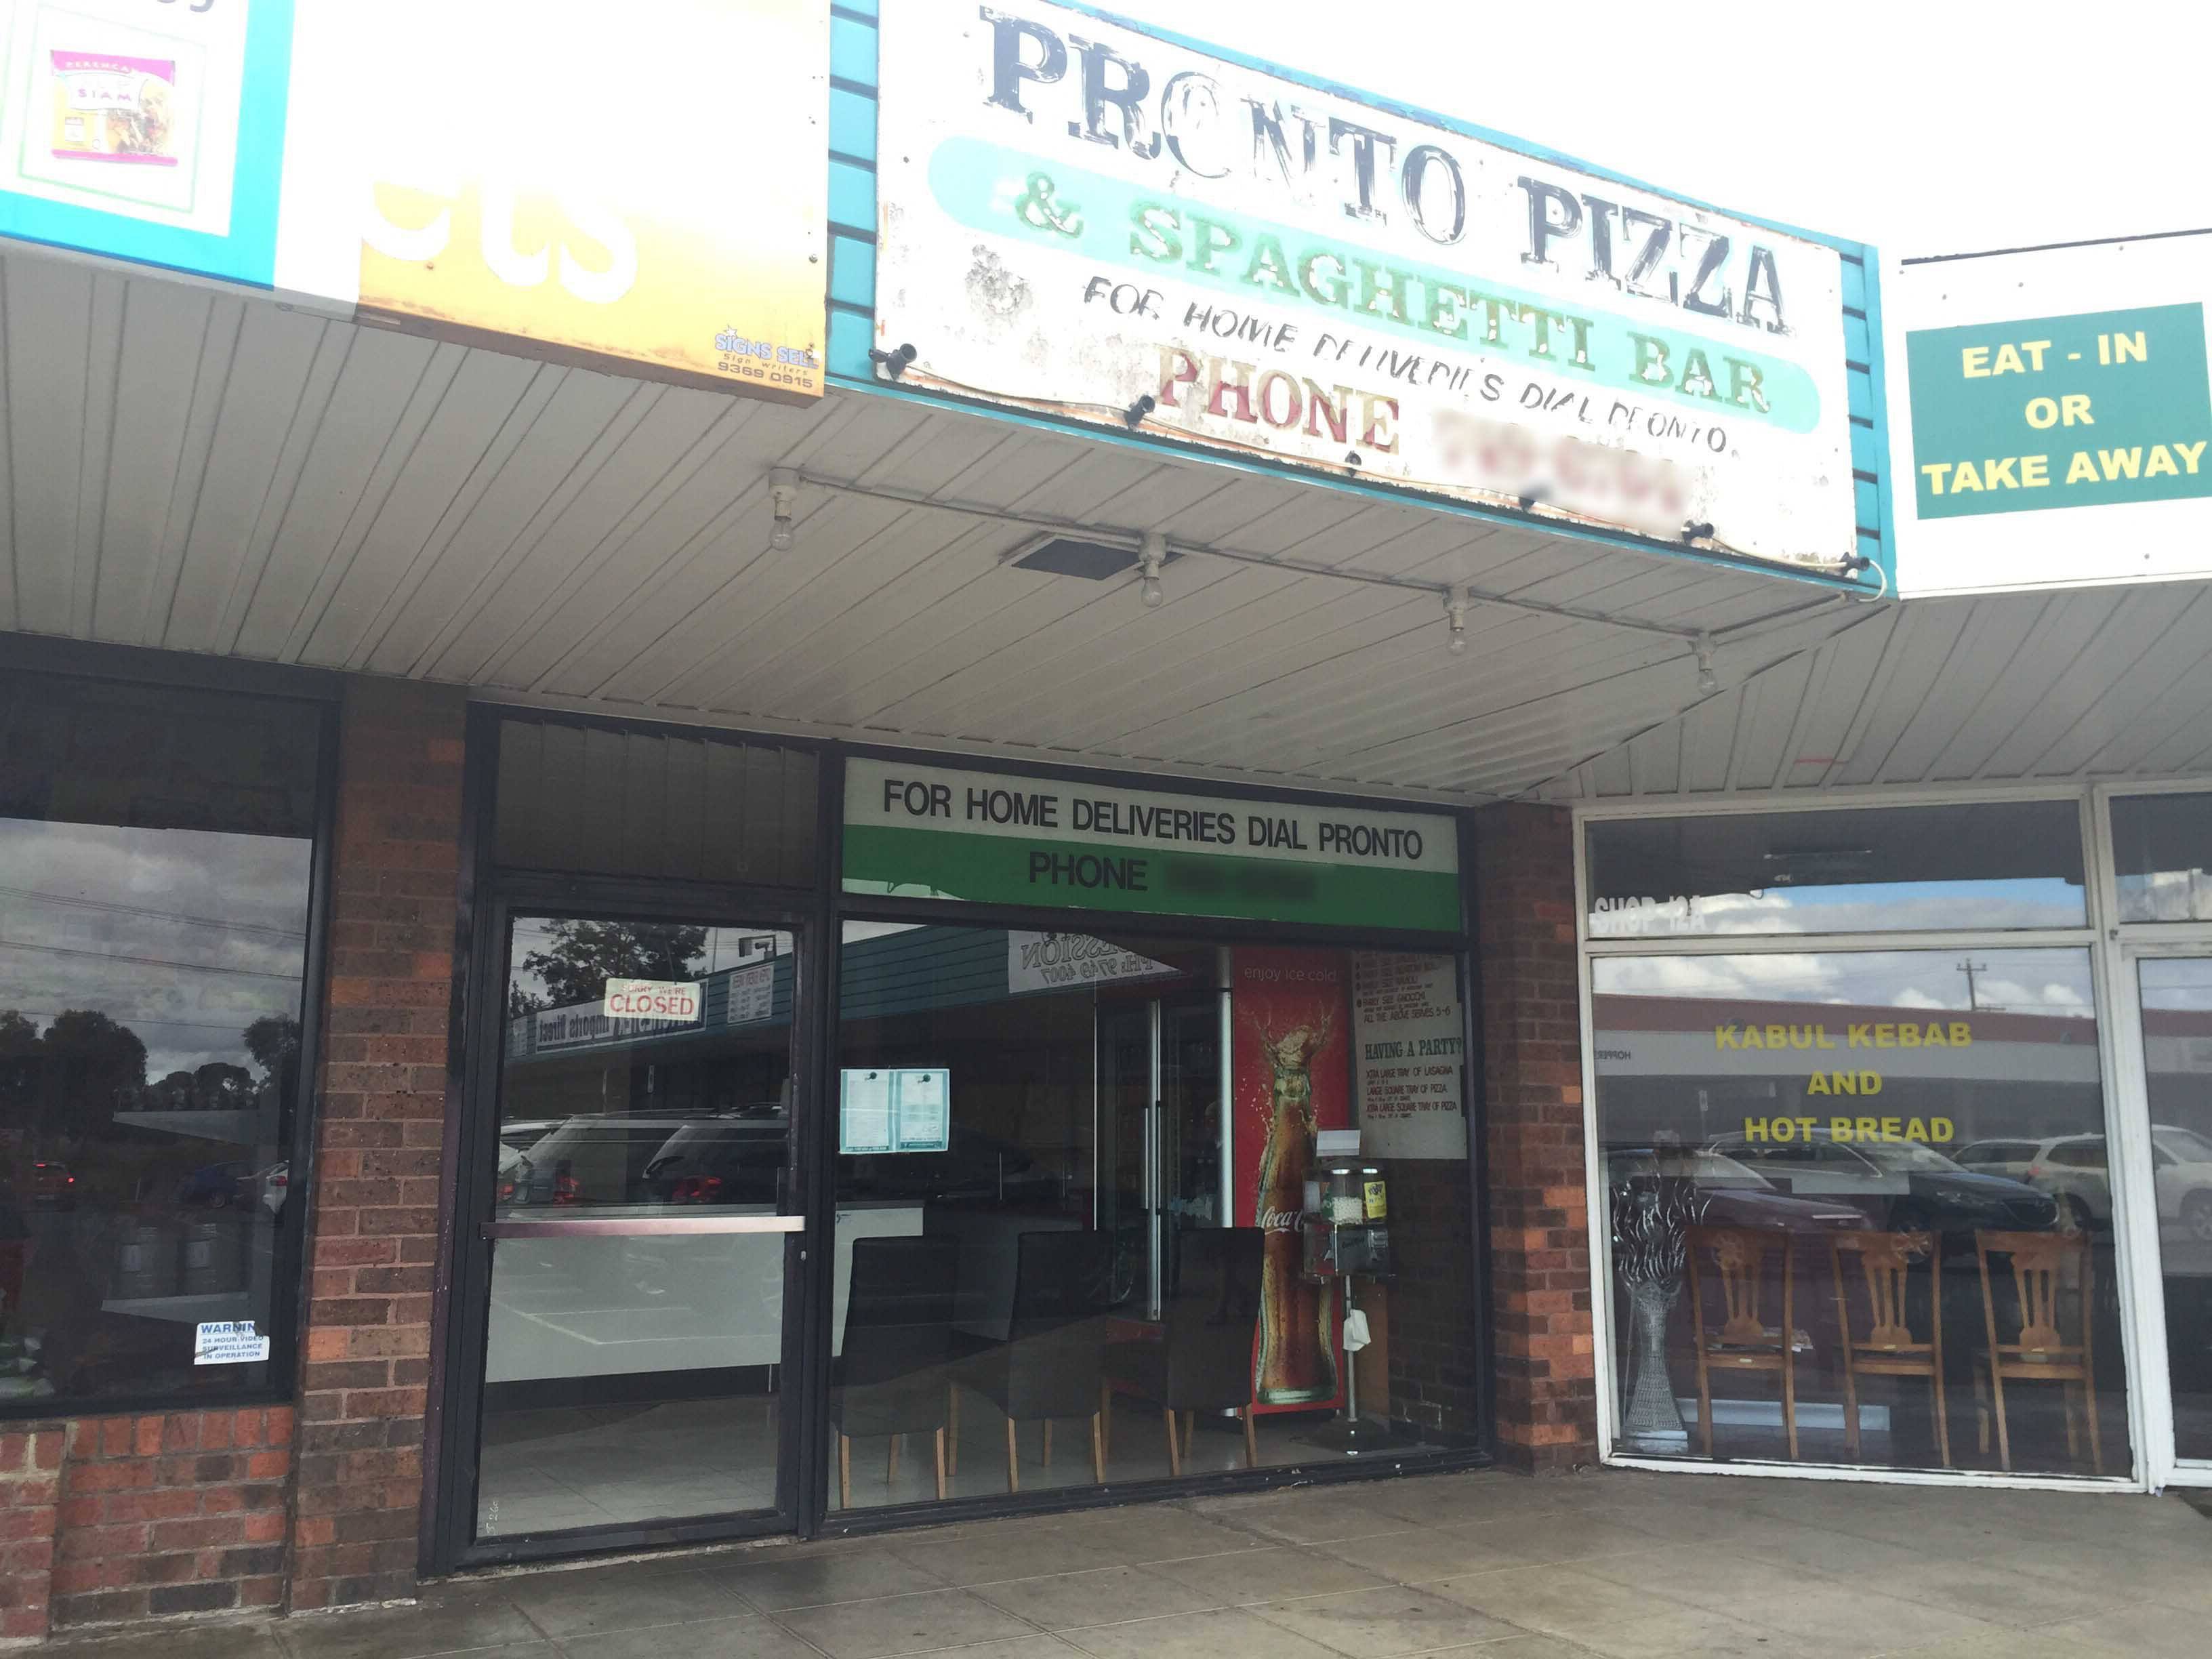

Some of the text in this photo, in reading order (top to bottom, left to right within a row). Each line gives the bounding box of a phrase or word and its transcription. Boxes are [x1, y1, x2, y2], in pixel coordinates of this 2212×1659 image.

[77, 88, 131, 102] SIAM
[980, 5, 1796, 337] PRONTO PIZZA
[1015, 171, 1773, 413] & SPAGHETTI BAR
[1084, 276, 1164, 320] FOR
[1184, 302, 1298, 353] HOME
[715, 333, 772, 360] SIGNS
[1962, 340, 2051, 378] EAT
[2098, 331, 2148, 365] IN
[718, 361, 813, 388] 9369 0915
[1160, 346, 1399, 455] PHONE
[2025, 394, 2095, 429] OR
[1921, 441, 2207, 495] TAKE AWAY
[884, 779, 1422, 860] FOR HOME DELIVERIES DIAL PRONTO
[1029, 851, 1149, 891] PHONE
[1595, 895, 1656, 933] SHOP
[1244, 966, 1336, 982] enjoy ice cold
[609, 994, 695, 1015] CLOSED
[1365, 1041, 1404, 1060] HAVING
[1407, 1040, 1415, 1057] A
[1715, 1023, 1973, 1050] KABUL KEBAB
[1807, 1071, 1883, 1096] AND
[1745, 1116, 1955, 1143] HOT BREAD
[1261, 1206, 1305, 1233] Coca-C
[203, 1343, 263, 1352] SURVEILLANCE
[215, 1351, 260, 1359] OPERATION
